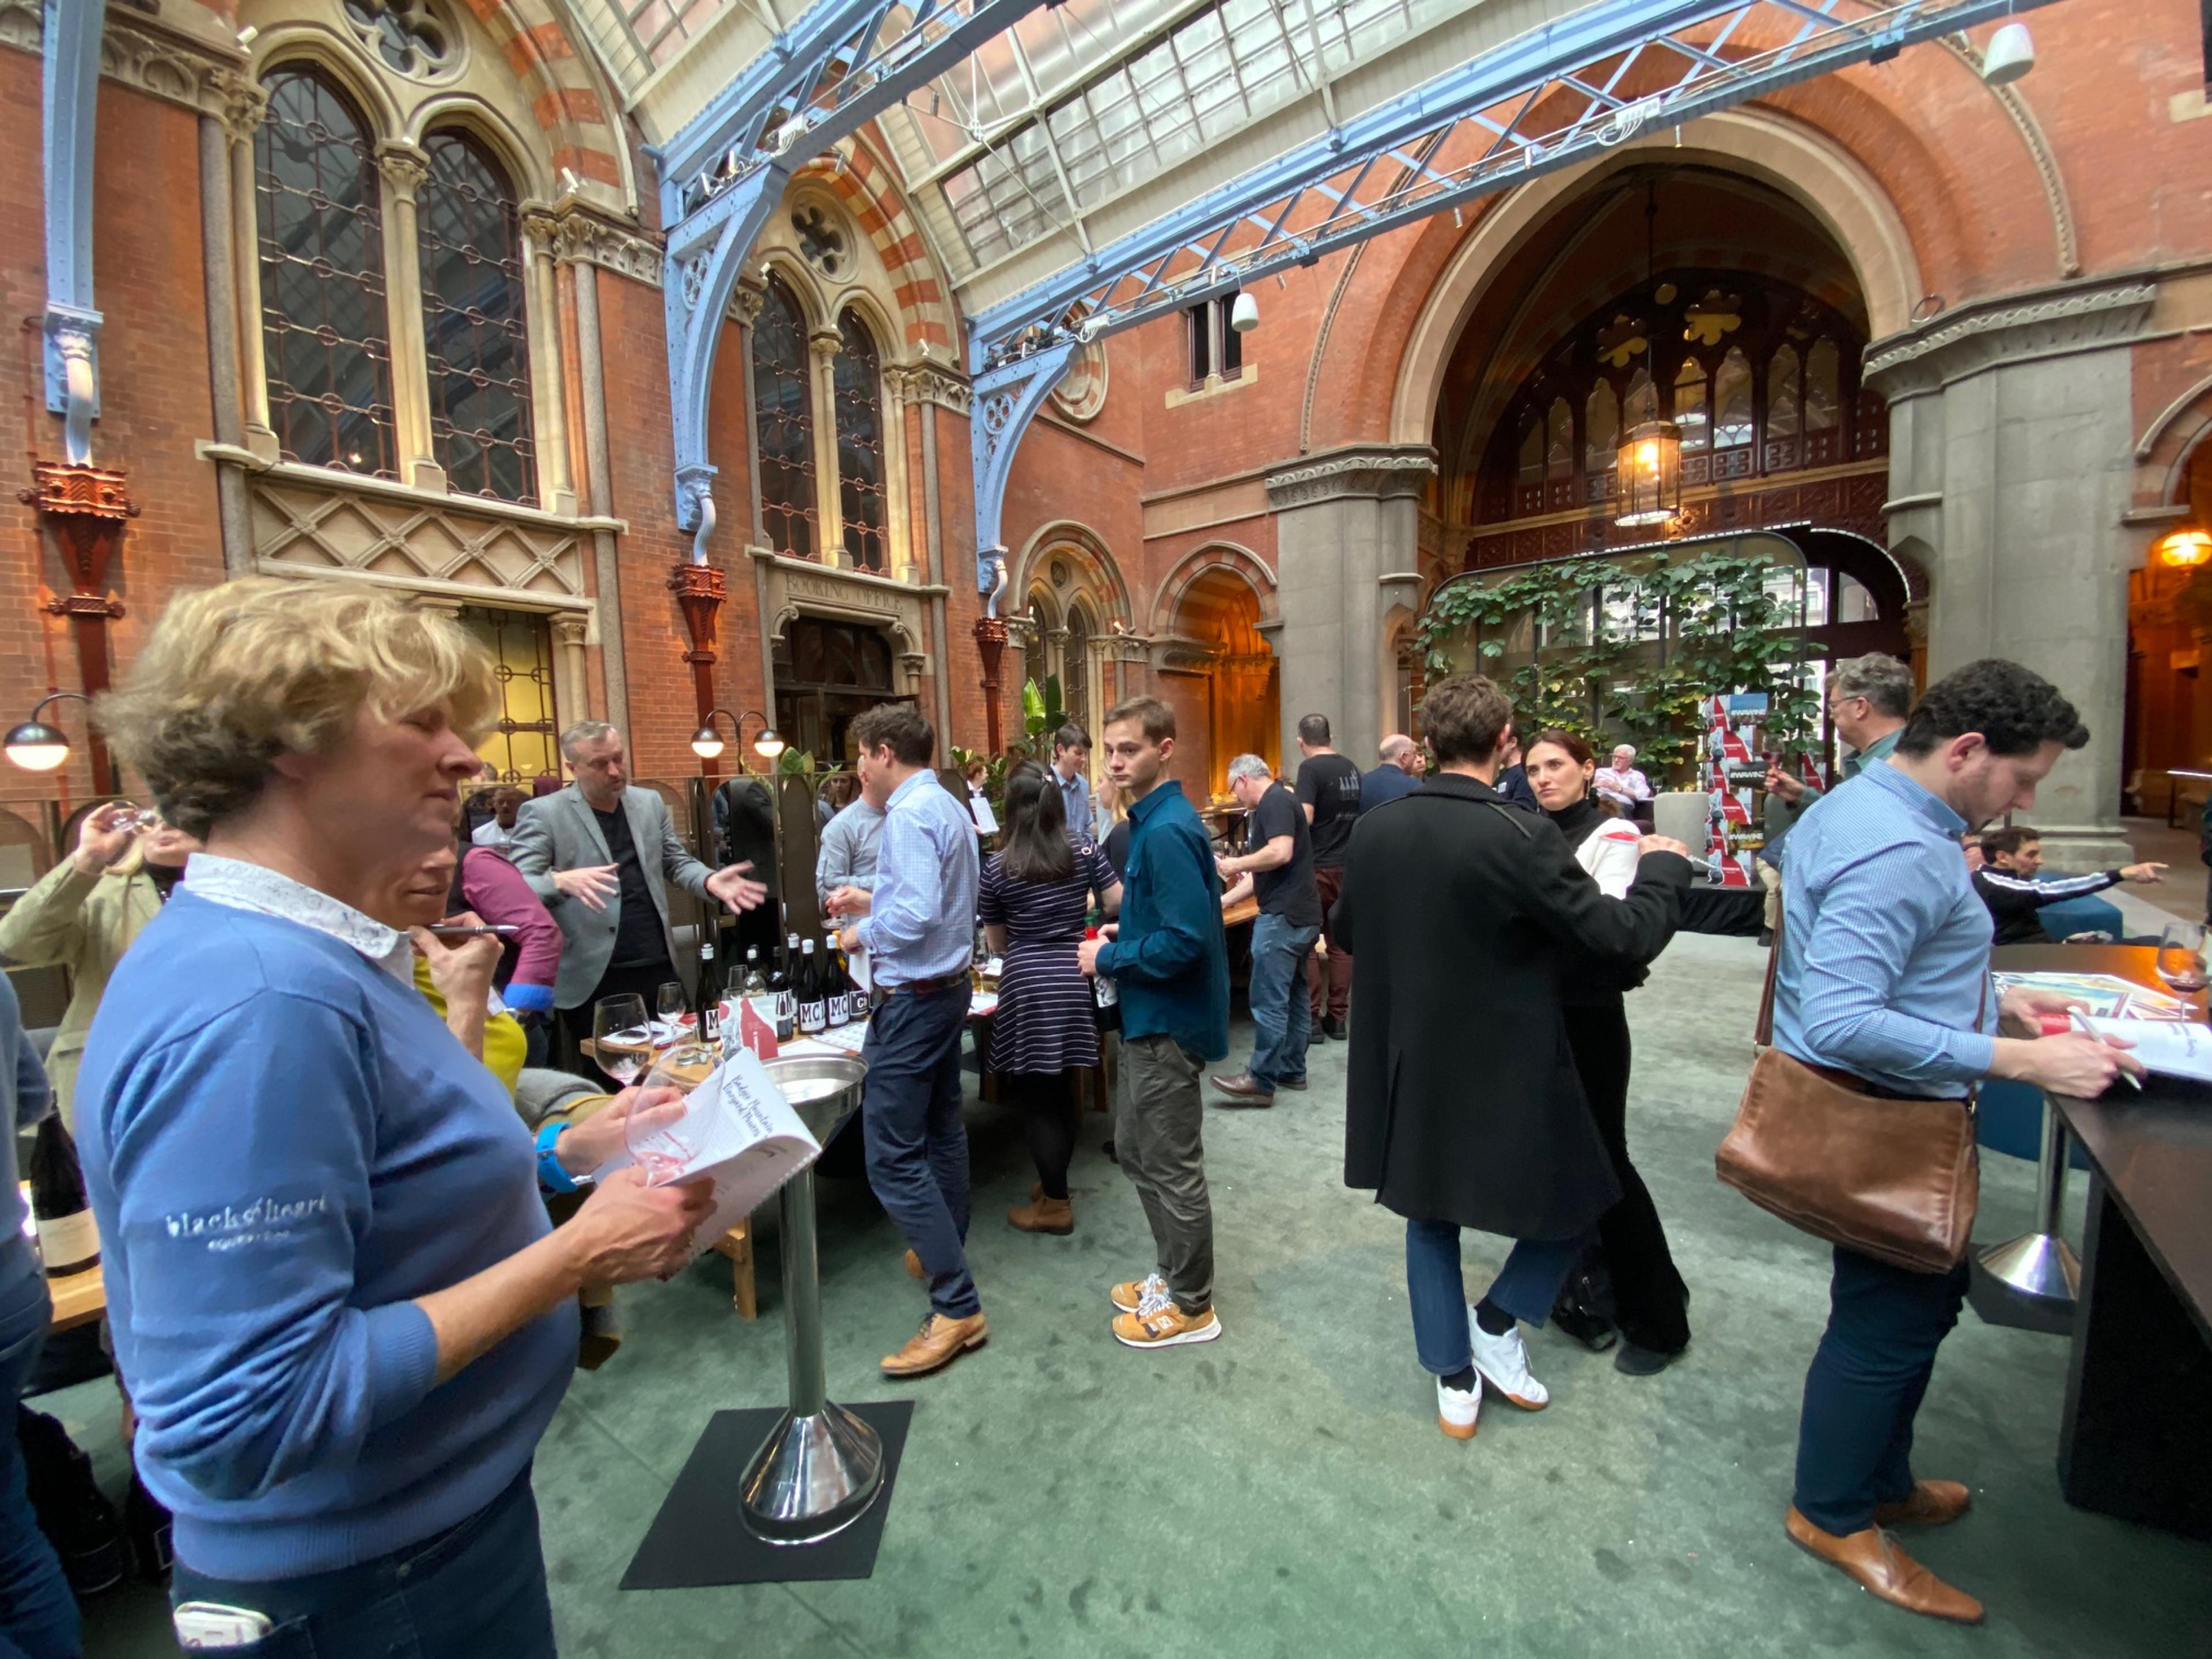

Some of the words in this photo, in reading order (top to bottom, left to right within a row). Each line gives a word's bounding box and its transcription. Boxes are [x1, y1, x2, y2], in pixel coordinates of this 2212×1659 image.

[786, 573, 849, 600] BOOKING
[856, 588, 903, 611] OFFICE
[748, 1099, 773, 1134] Mountain
